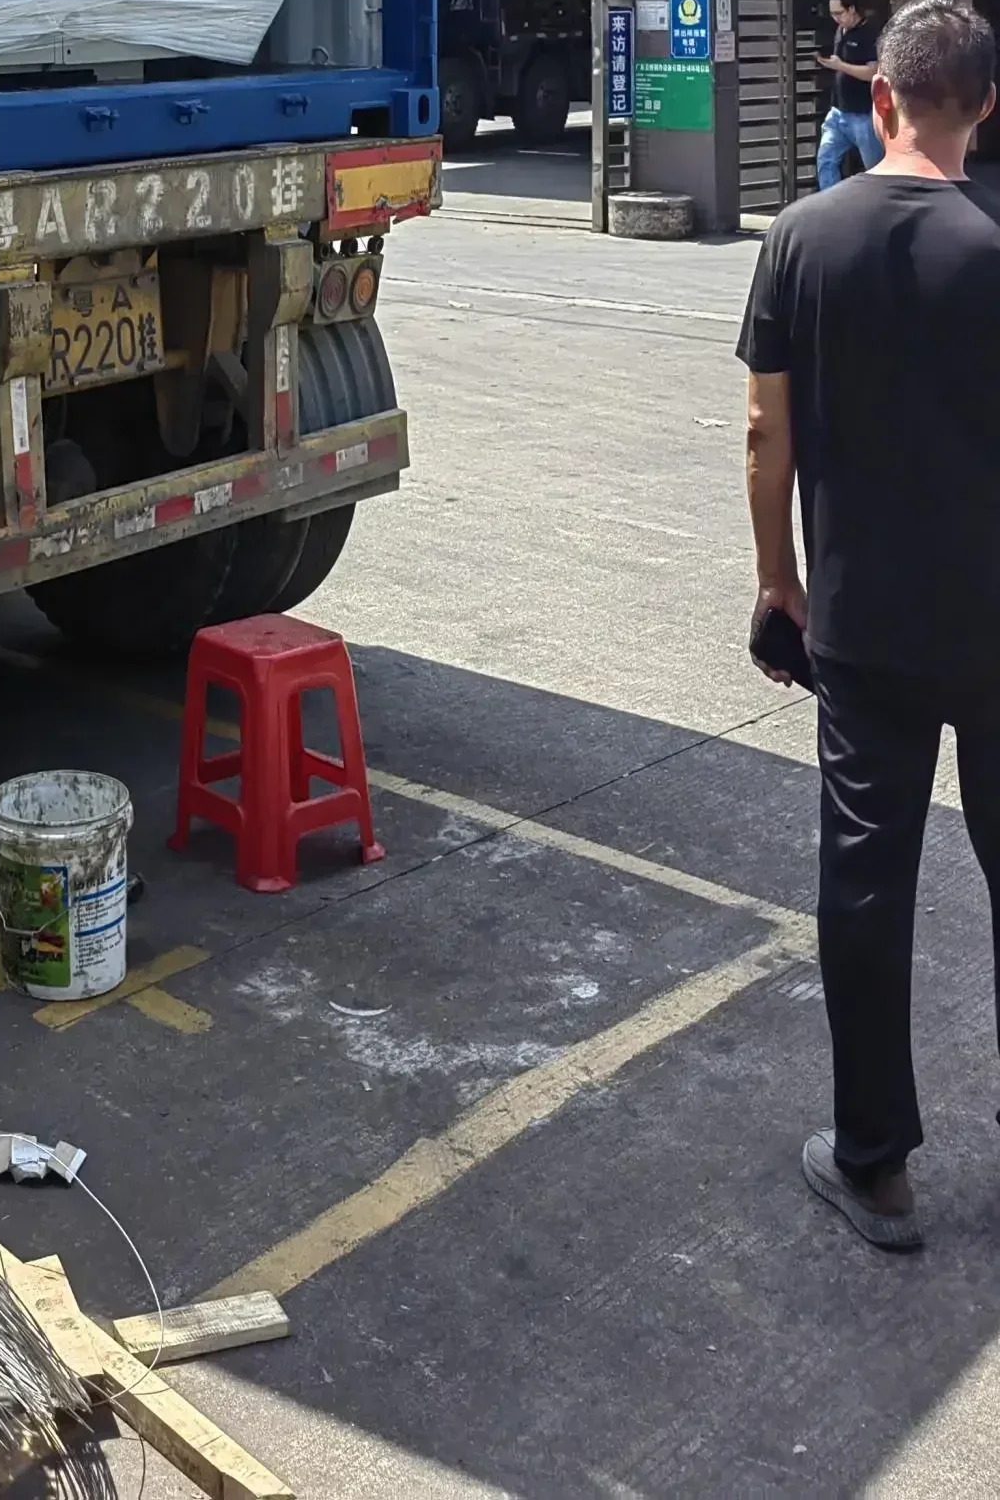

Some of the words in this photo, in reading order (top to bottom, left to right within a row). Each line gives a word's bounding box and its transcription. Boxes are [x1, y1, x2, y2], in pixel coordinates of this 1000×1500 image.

[612, 16, 627, 112] 来访请登记
[684, 47, 696, 55] 110
[51, 311, 158, 385] R220挂
